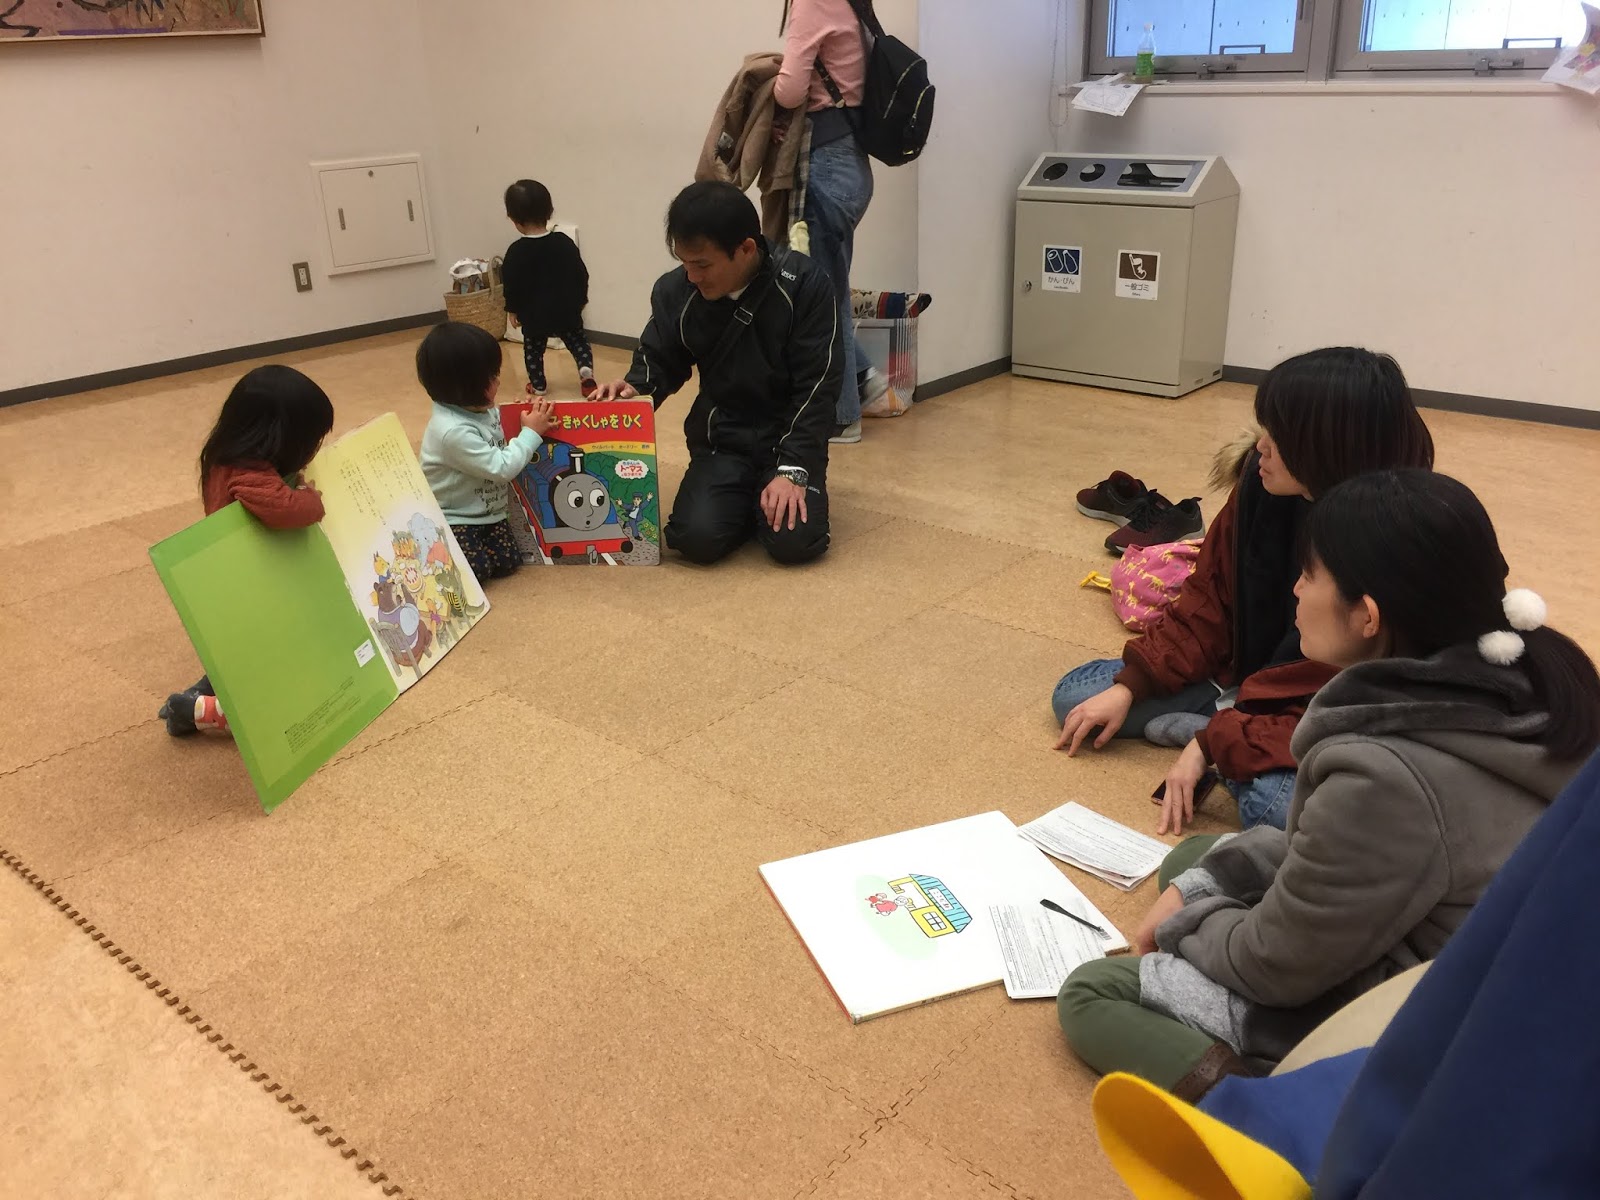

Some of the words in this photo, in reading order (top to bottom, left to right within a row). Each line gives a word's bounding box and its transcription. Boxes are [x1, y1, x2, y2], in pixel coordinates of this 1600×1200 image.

[1124, 283, 1149, 292] 一般ゴミ
[562, 413, 619, 429] きゃくしゃを
[622, 413, 642, 428] ひく
[620, 464, 643, 472] トーマス
